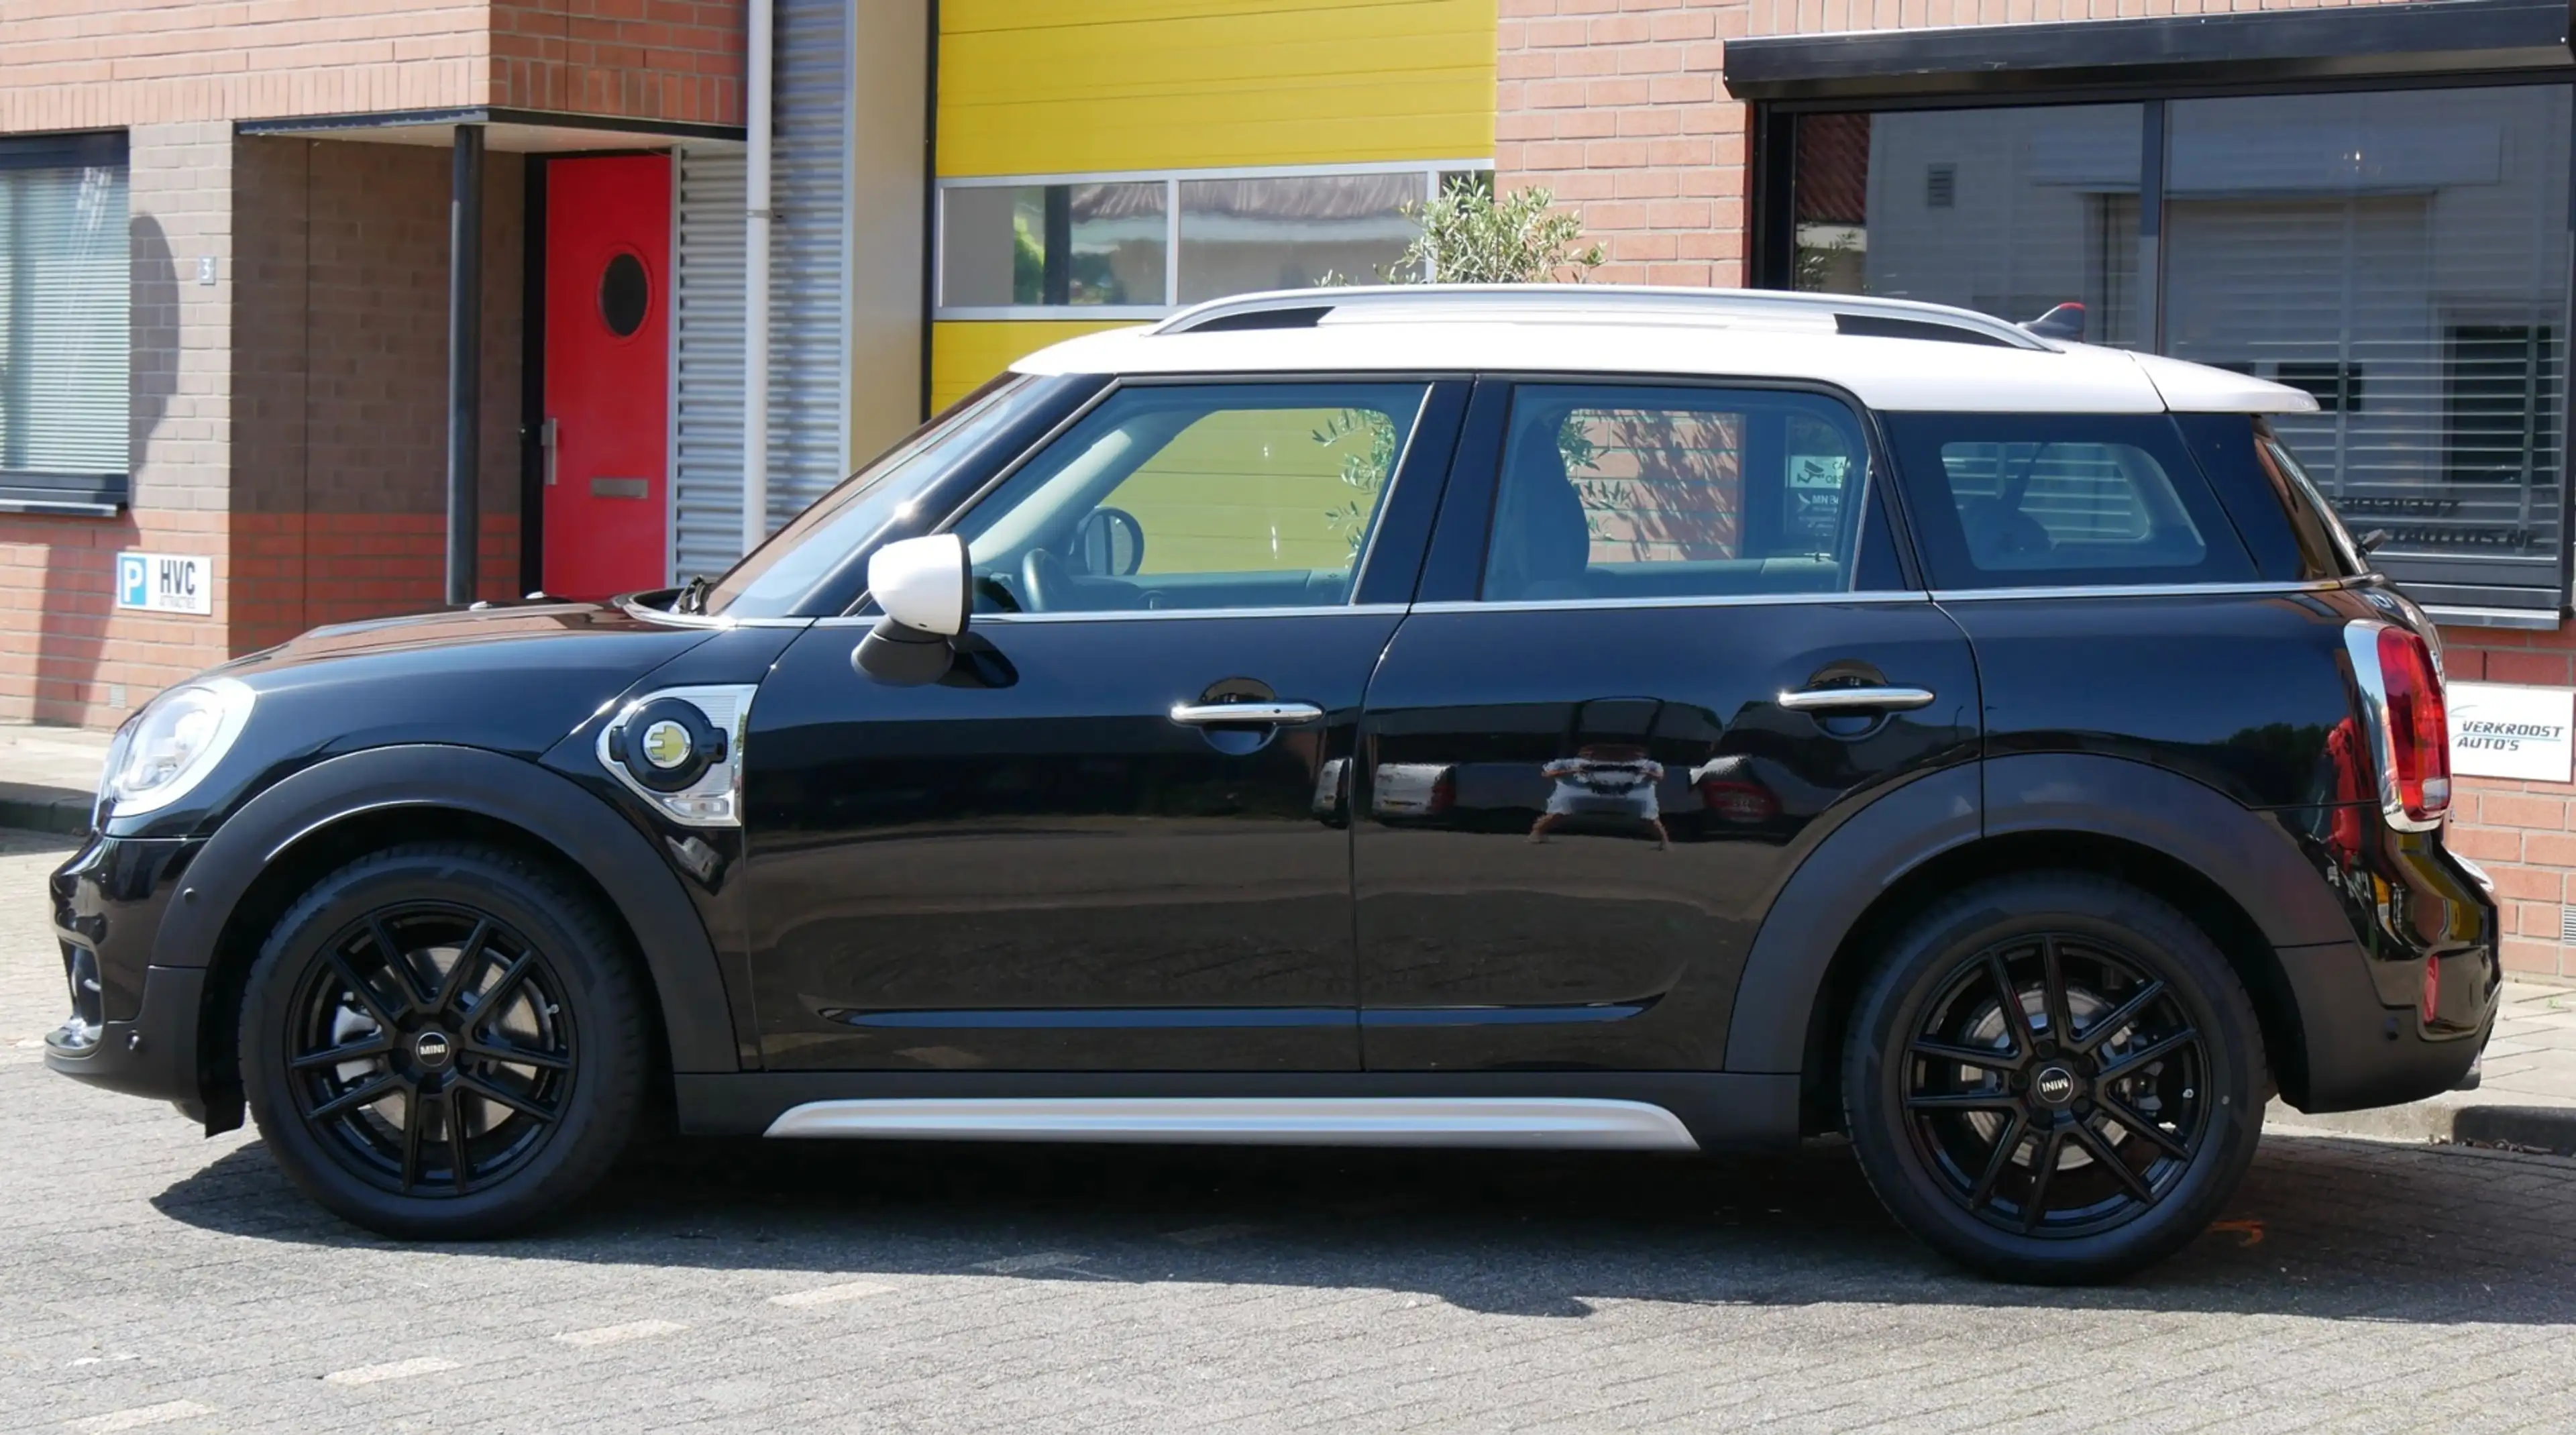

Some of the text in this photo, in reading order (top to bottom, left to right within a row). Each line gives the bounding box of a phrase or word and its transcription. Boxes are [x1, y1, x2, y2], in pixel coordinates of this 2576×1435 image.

[201, 258, 211, 279] 3
[123, 559, 195, 602] P HVC
[2462, 720, 2565, 737] VERKROOST
[2457, 736, 2520, 751] AUTO'S
[419, 1044, 445, 1055] MINI
[2041, 1077, 2069, 1092] MINI
